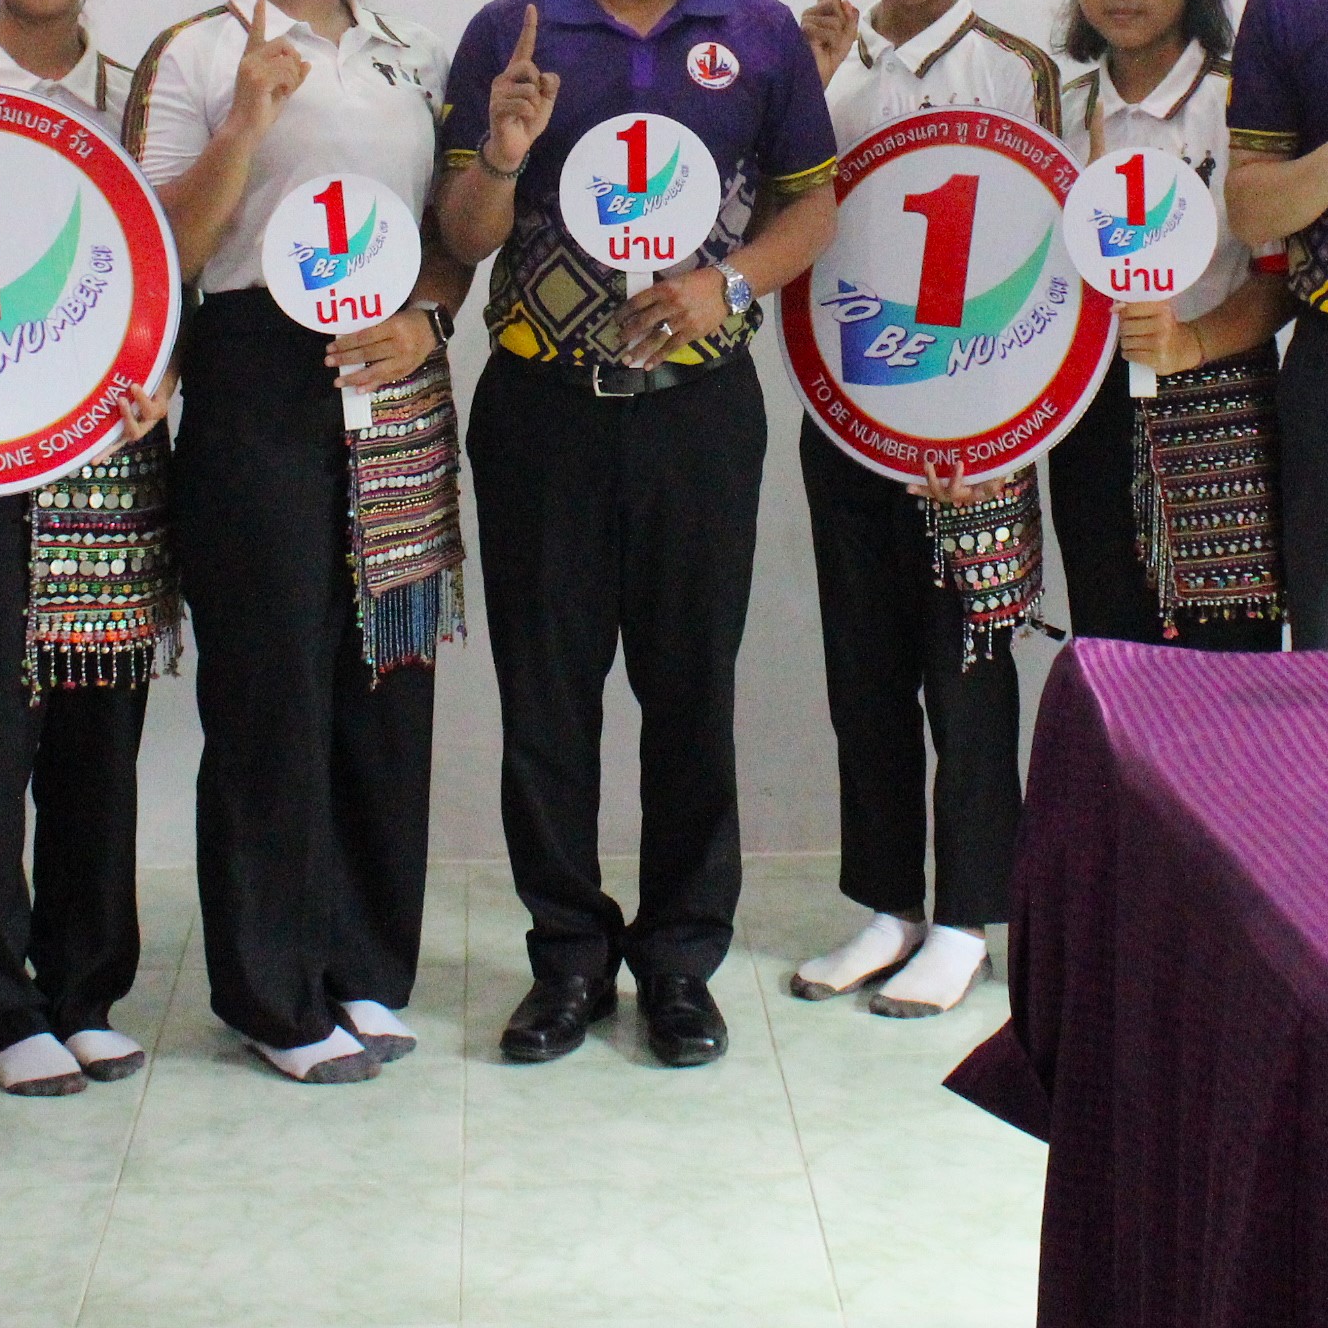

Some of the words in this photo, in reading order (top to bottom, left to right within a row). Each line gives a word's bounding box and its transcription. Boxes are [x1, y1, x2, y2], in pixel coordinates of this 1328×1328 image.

[68, 129, 94, 159] วัน
[975, 118, 991, 140] บี
[616, 119, 648, 194] 1
[607, 194, 637, 216] BE
[1115, 154, 1146, 226] 1
[313, 180, 350, 256] 1
[608, 226, 676, 261] น่าน
[902, 173, 980, 329] 1
[1108, 227, 1138, 248] BE
[311, 258, 340, 279] BE
[1110, 258, 1175, 293] น่าน
[316, 288, 383, 325] น่าน
[820, 280, 883, 324] TO
[863, 324, 937, 368] BE
[946, 301, 1059, 377] NUMBER
[38, 373, 133, 458] SONGKWAE
[810, 372, 832, 402] TO
[828, 401, 851, 425] BE
[849, 419, 920, 463] NUMBER
[923, 447, 962, 466] ONE
[967, 397, 1059, 463] SONGKWAE
